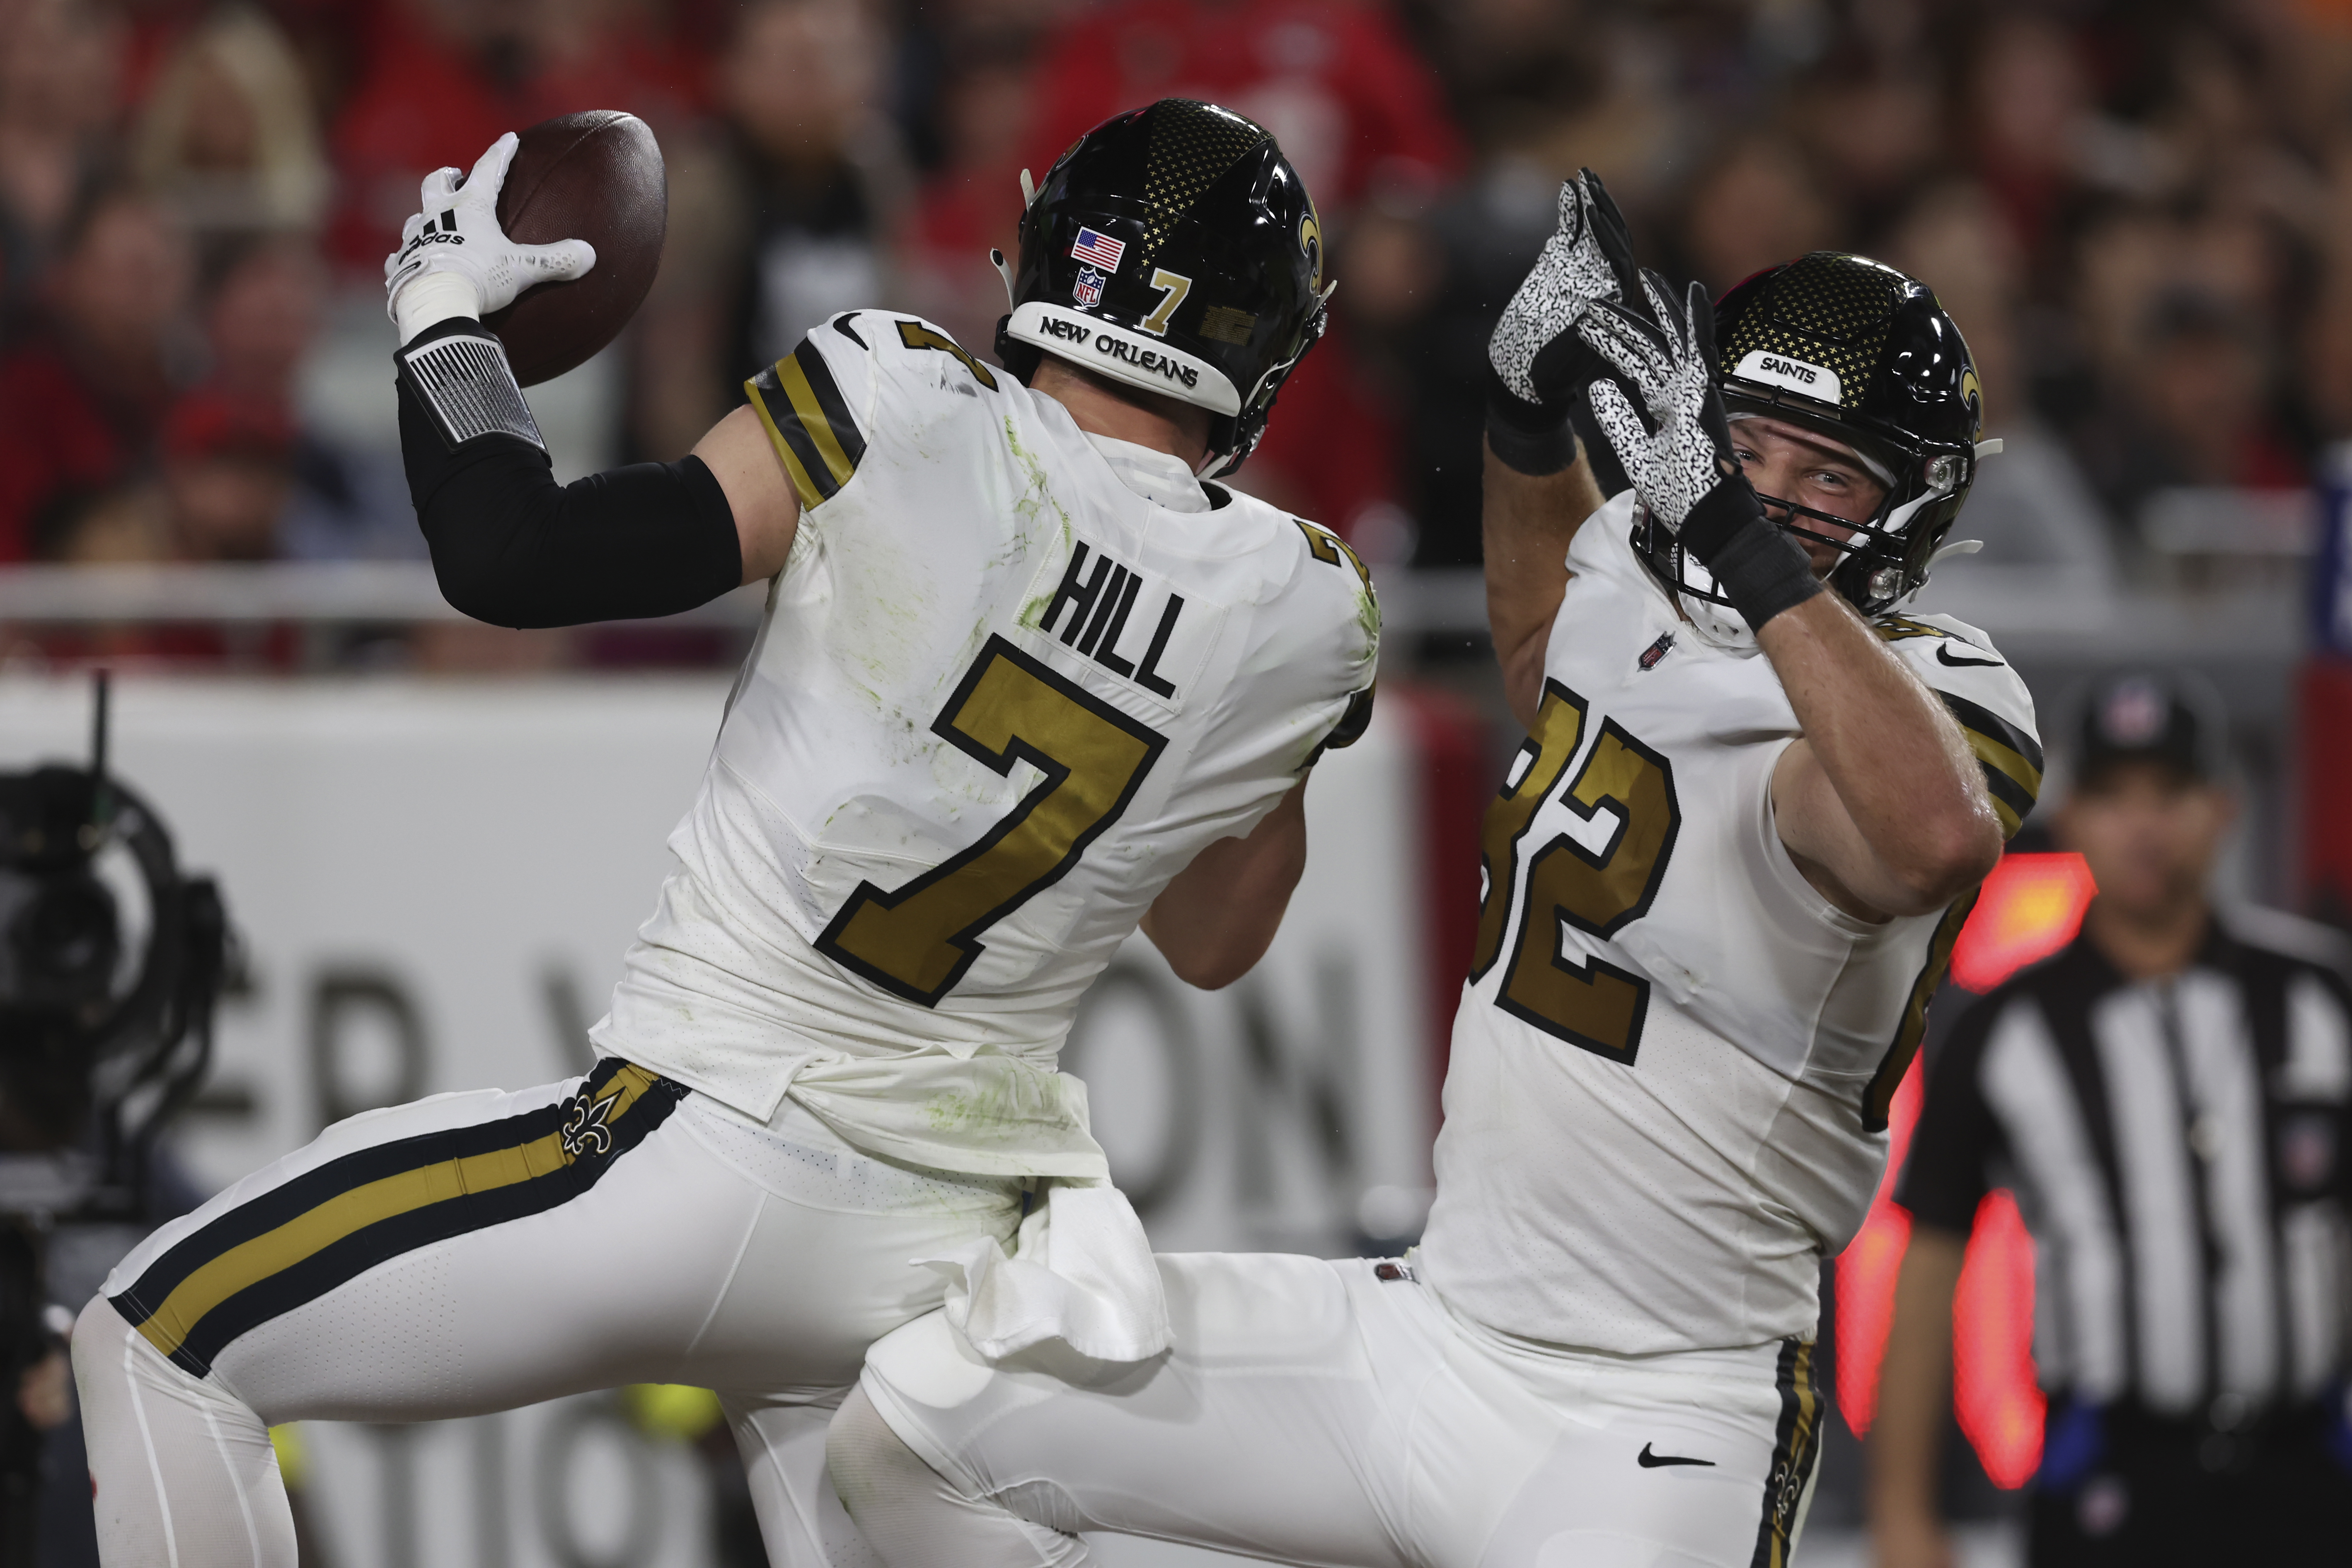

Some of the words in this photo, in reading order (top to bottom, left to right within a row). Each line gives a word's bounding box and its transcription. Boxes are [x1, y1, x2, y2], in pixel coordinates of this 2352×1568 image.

[1076, 283, 1096, 303] NFL
[1140, 267, 1193, 337] 7
[1039, 316, 1091, 344] NEW
[1095, 334, 1198, 387] ORLEANS
[1760, 357, 1817, 384] SAINTS
[1292, 518, 1374, 608] 7
[1038, 540, 1185, 699] HILL
[812, 632, 1170, 1009] 7
[1469, 676, 1682, 1067] 82
